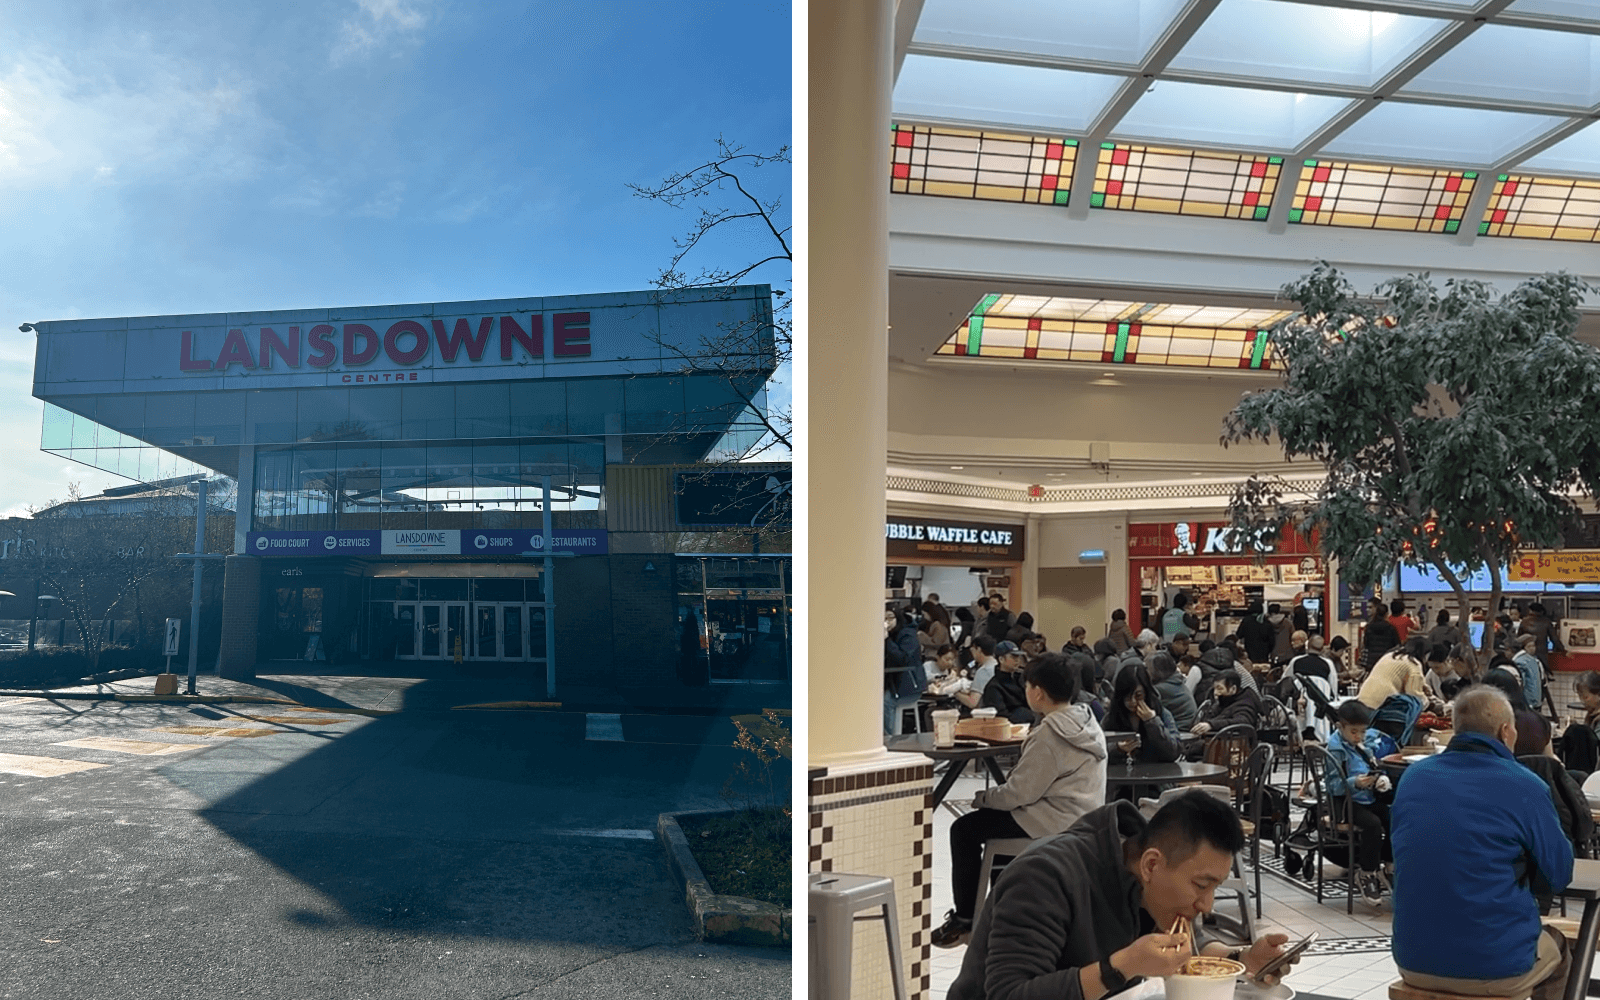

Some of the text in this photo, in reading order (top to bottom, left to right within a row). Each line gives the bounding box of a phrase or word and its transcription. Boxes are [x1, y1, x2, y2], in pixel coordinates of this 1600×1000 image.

[179, 311, 592, 372] LANSDOWNE
[341, 372, 418, 383] CENTRE
[395, 532, 446, 544] LANSDOWNE
[926, 526, 978, 543] WAFFLE
[980, 530, 1012, 545] CAFE
[270, 538, 310, 548] FOOD COURT
[338, 537, 371, 547] SERVICES
[489, 537, 513, 547] SHOPS
[551, 537, 597, 547] ESTAURANTS
[117, 546, 145, 559] BAR
[281, 566, 303, 576] earls
